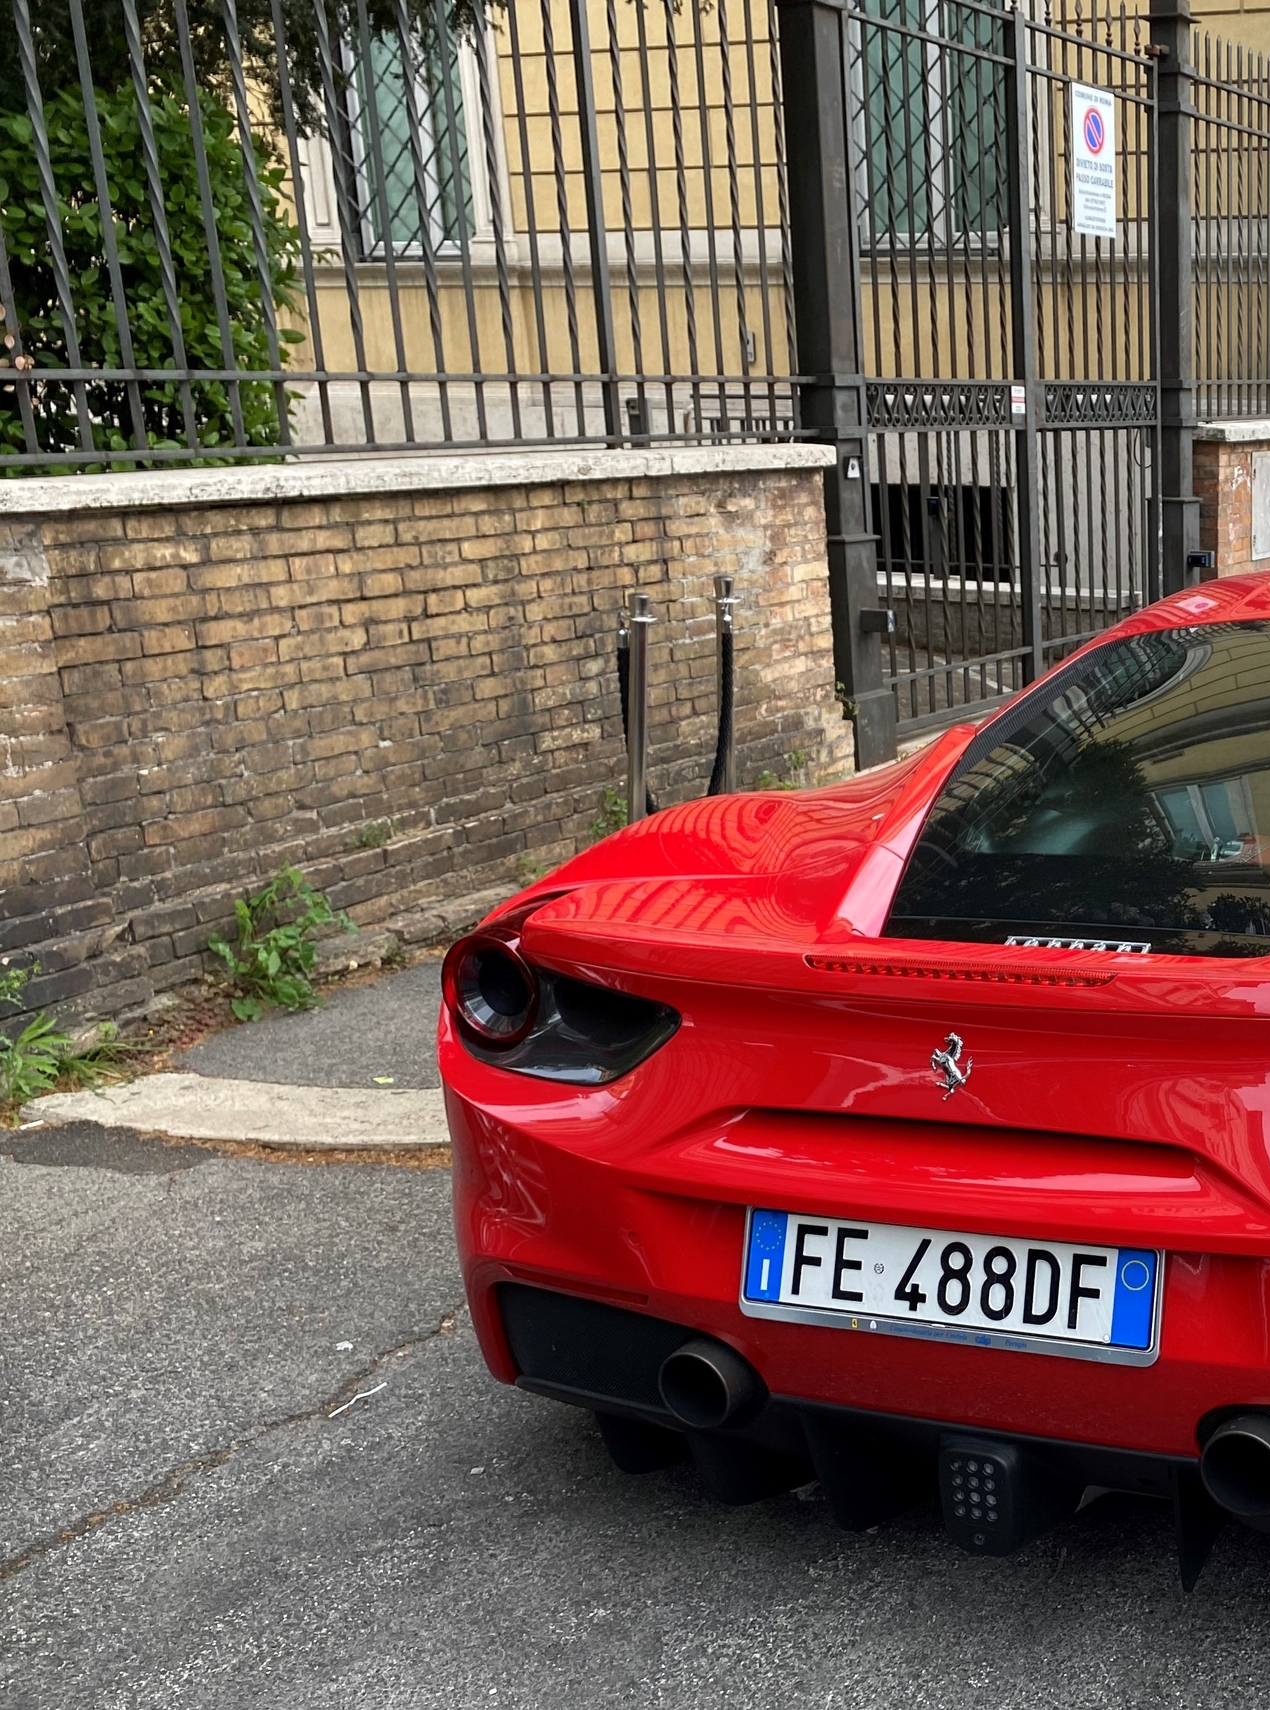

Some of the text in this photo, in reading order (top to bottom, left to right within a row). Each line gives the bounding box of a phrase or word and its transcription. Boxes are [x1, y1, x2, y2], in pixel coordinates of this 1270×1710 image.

[1075, 90, 1093, 101] COMUNE
[1100, 96, 1112, 106] ROMA
[1076, 157, 1113, 174] DIVIETO DI SOSTA
[1076, 172, 1114, 189] PASSO CARRABILE
[790, 1222, 869, 1303] FE
[894, 1237, 1108, 1331] 488DF
